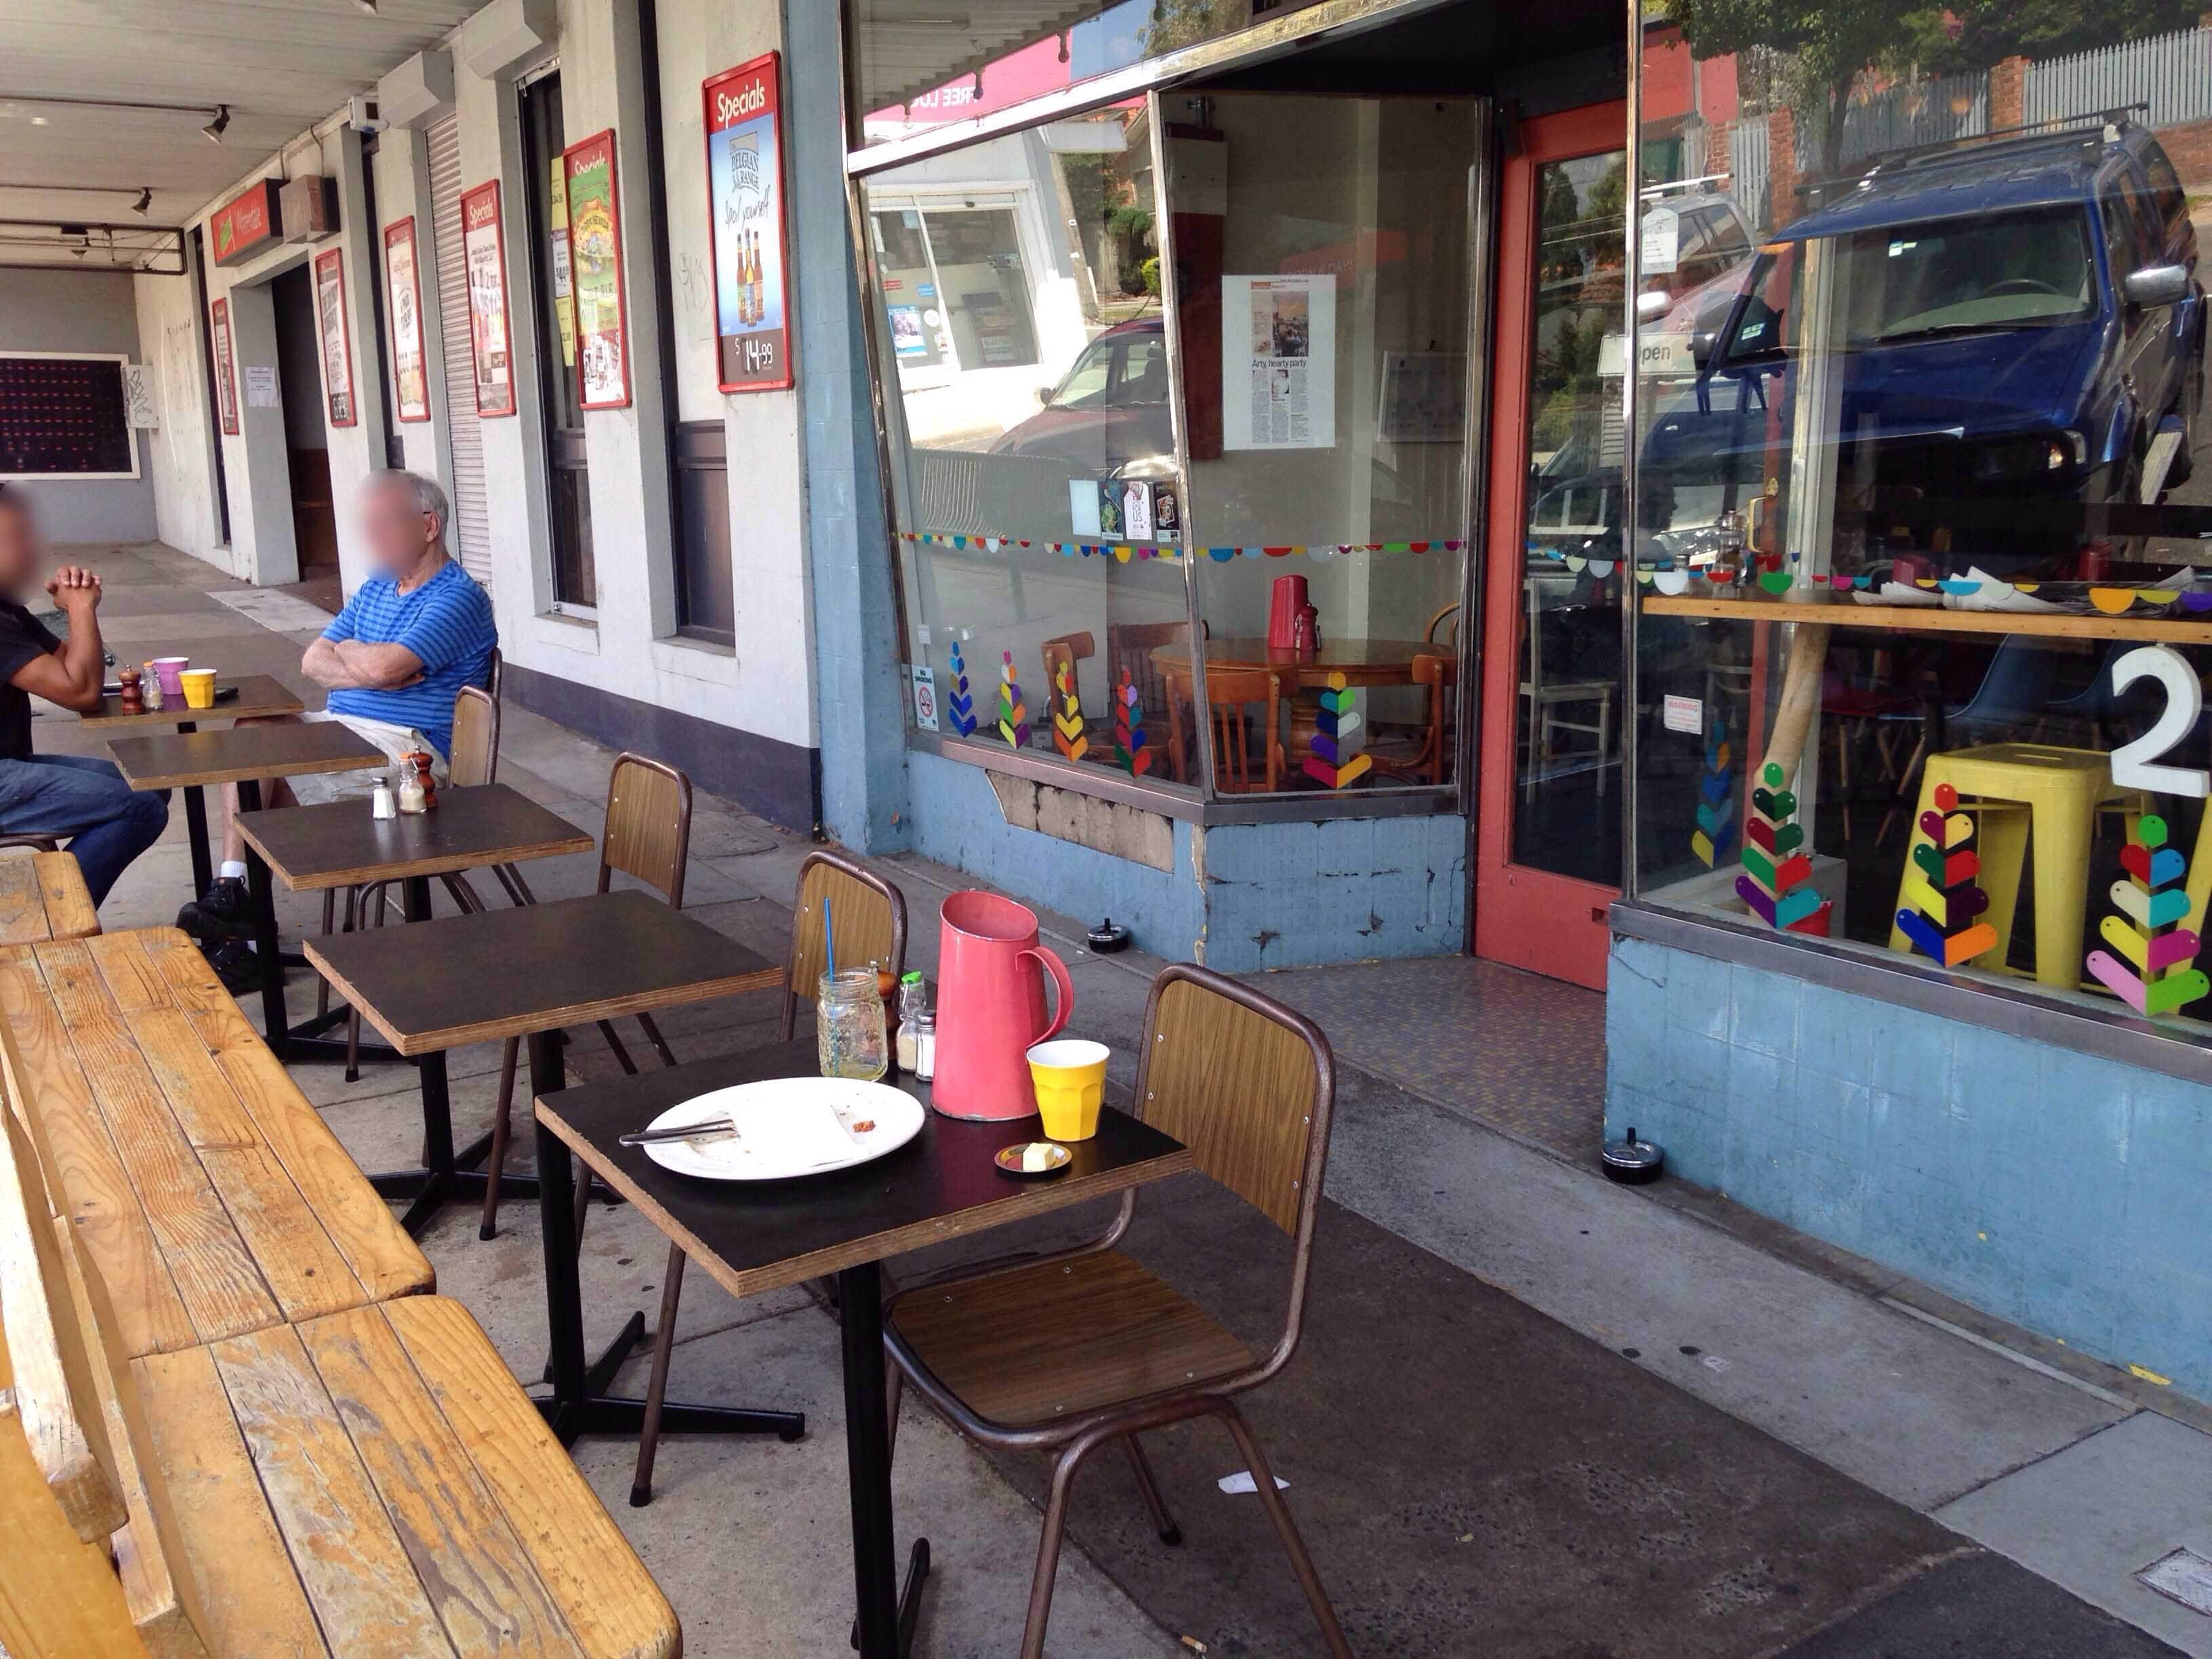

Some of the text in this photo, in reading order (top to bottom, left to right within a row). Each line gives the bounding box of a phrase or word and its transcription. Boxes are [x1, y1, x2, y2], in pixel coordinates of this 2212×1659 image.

[718, 79, 765, 129] Specials
[731, 151, 759, 172] BELGIAN
[740, 170, 760, 190] RANGE
[470, 197, 493, 230] Specials
[742, 184, 771, 230] yourself
[1269, 359, 1289, 369] hearty
[1290, 359, 1307, 369] party
[914, 676, 933, 684] SMOKING
[2110, 645, 2211, 798] 2
